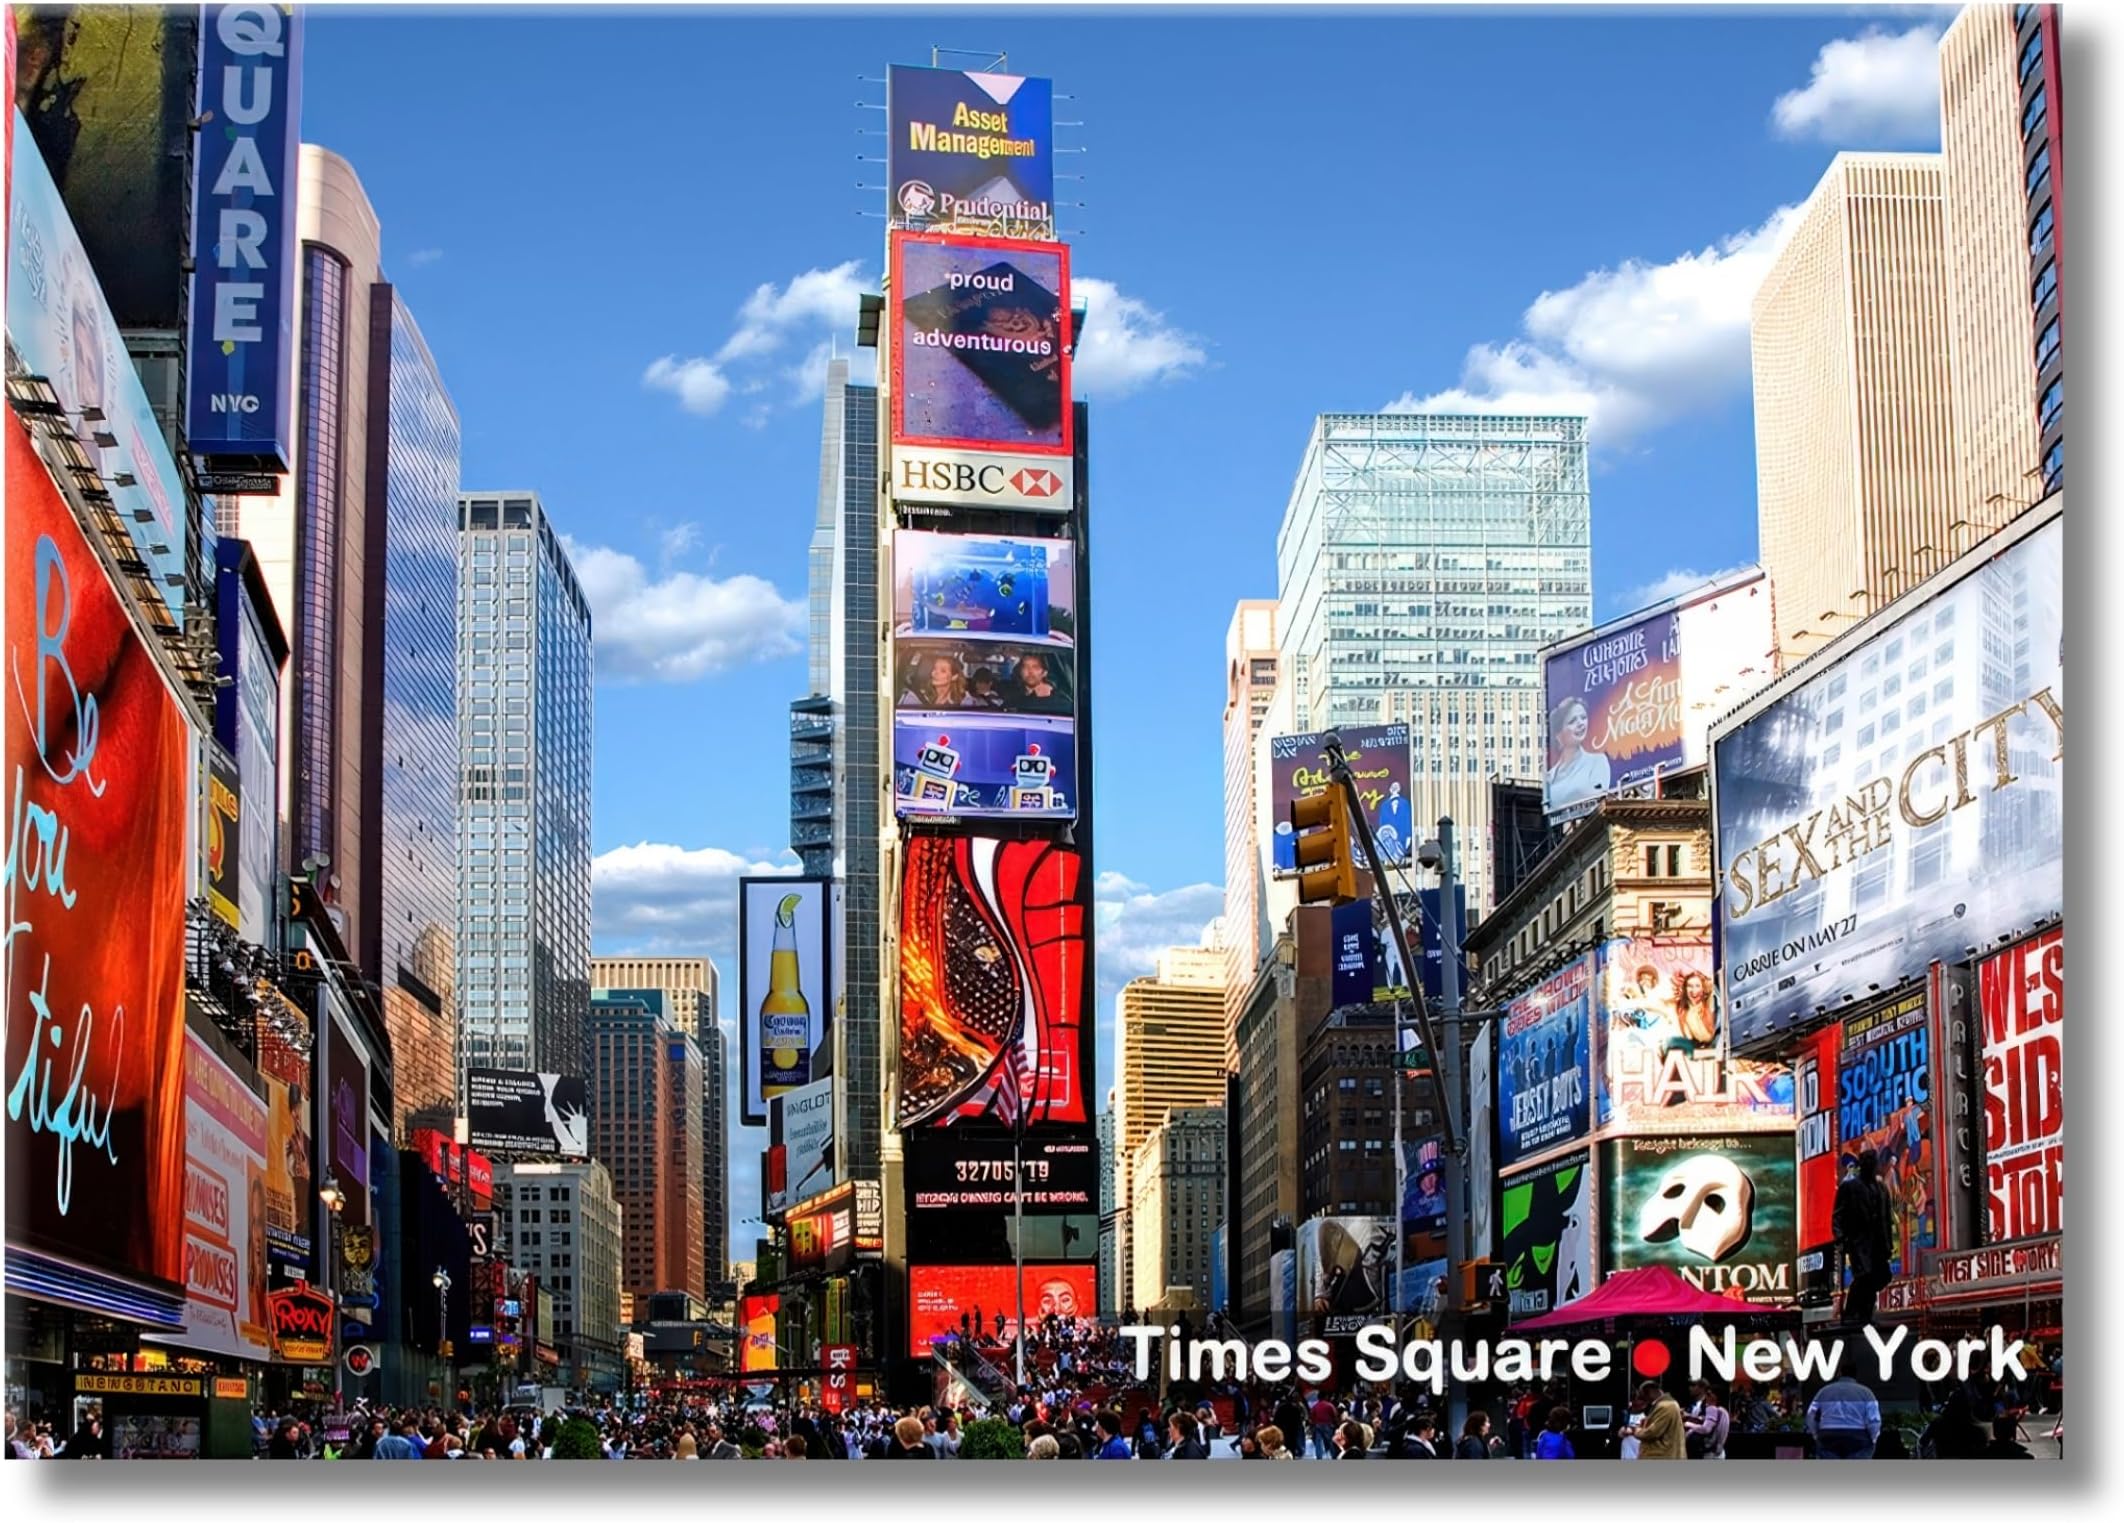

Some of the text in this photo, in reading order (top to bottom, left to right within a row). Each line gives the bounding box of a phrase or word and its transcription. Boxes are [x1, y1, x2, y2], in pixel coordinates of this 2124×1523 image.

[953, 101, 1008, 133] Asset
[910, 120, 1035, 160] Management
[939, 192, 1050, 221] Prudential
[949, 272, 1014, 291] proud
[912, 328, 1051, 355] adventurous
[210, 394, 260, 413] NYC
[901, 459, 1005, 495] HSBC
[12, 533, 106, 797] Be
[1729, 686, 2064, 920] SEX AND THE CITY
[1733, 949, 1780, 983] CARRIE
[1782, 936, 1806, 961] ON
[1839, 914, 1858, 937] 27
[1841, 1027, 1928, 1105] SOUTH
[275, 1299, 329, 1334] ROXY
